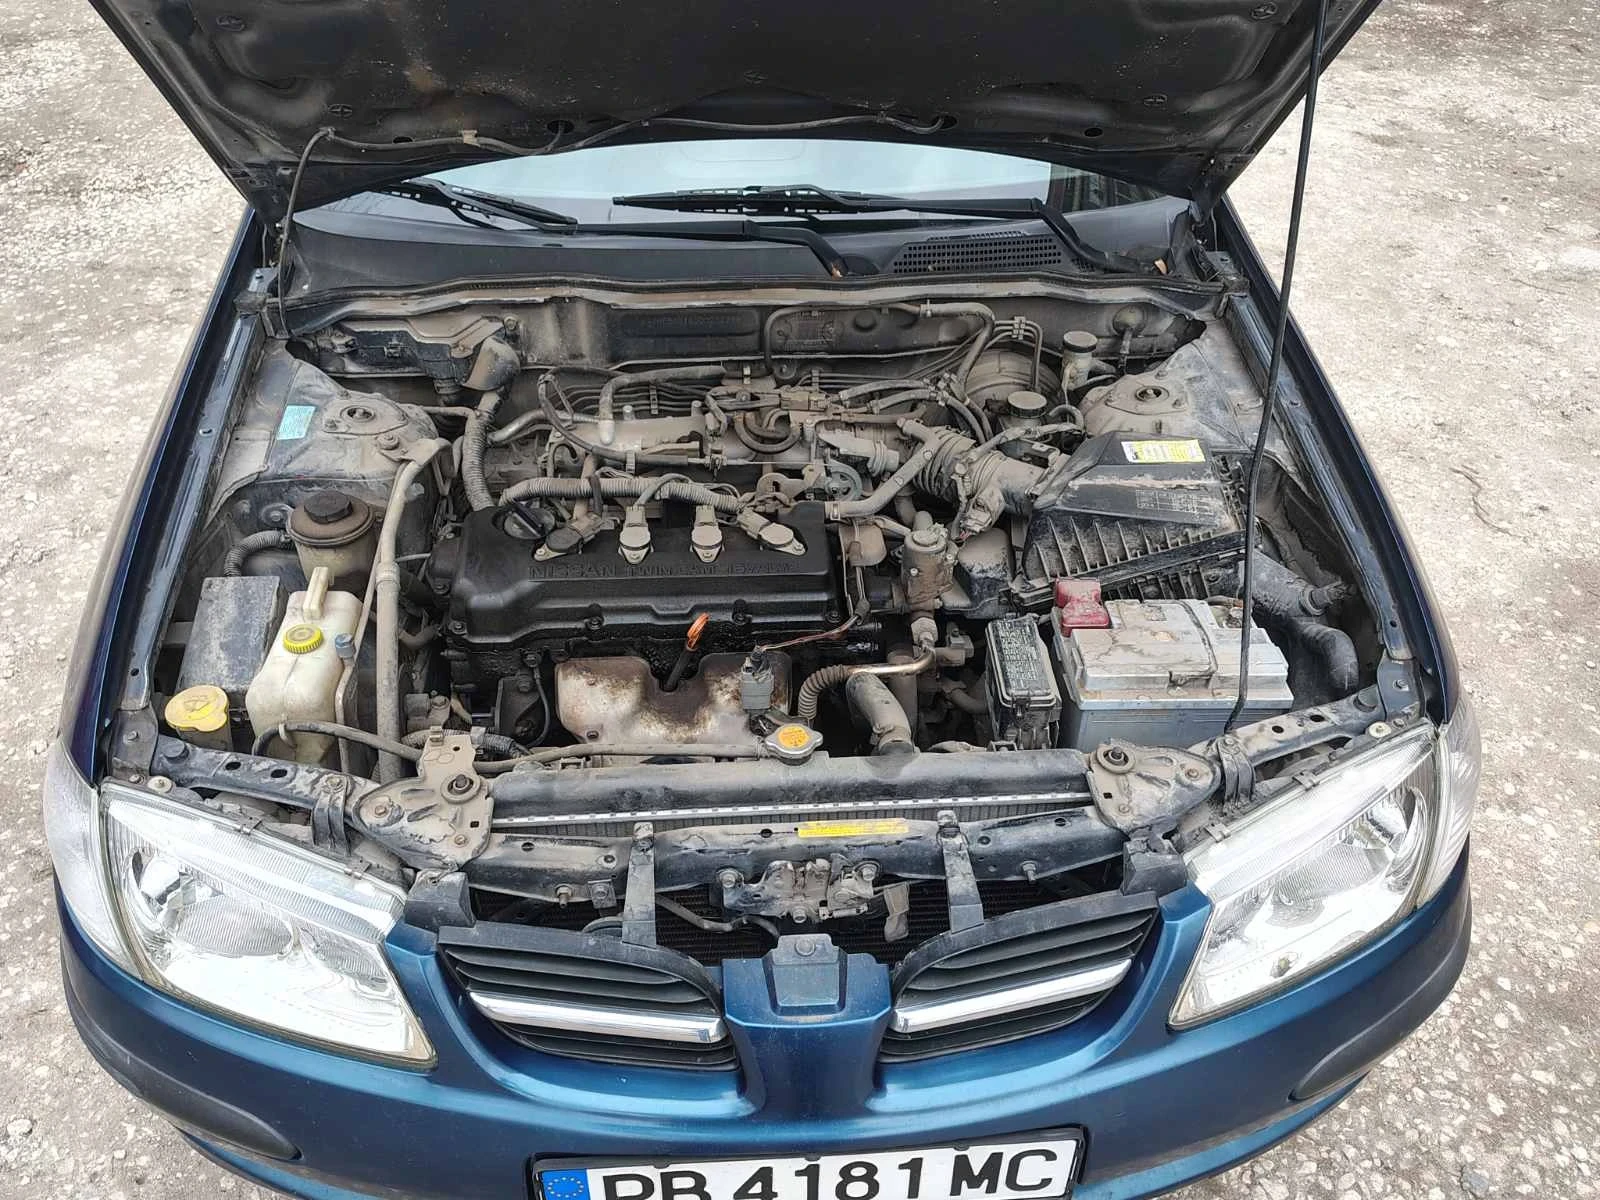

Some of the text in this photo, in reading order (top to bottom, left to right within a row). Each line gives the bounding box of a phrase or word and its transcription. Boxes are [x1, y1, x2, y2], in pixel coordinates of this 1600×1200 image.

[529, 561, 617, 578] NISSAN
[602, 1148, 1058, 1200] PB 4181 MC
